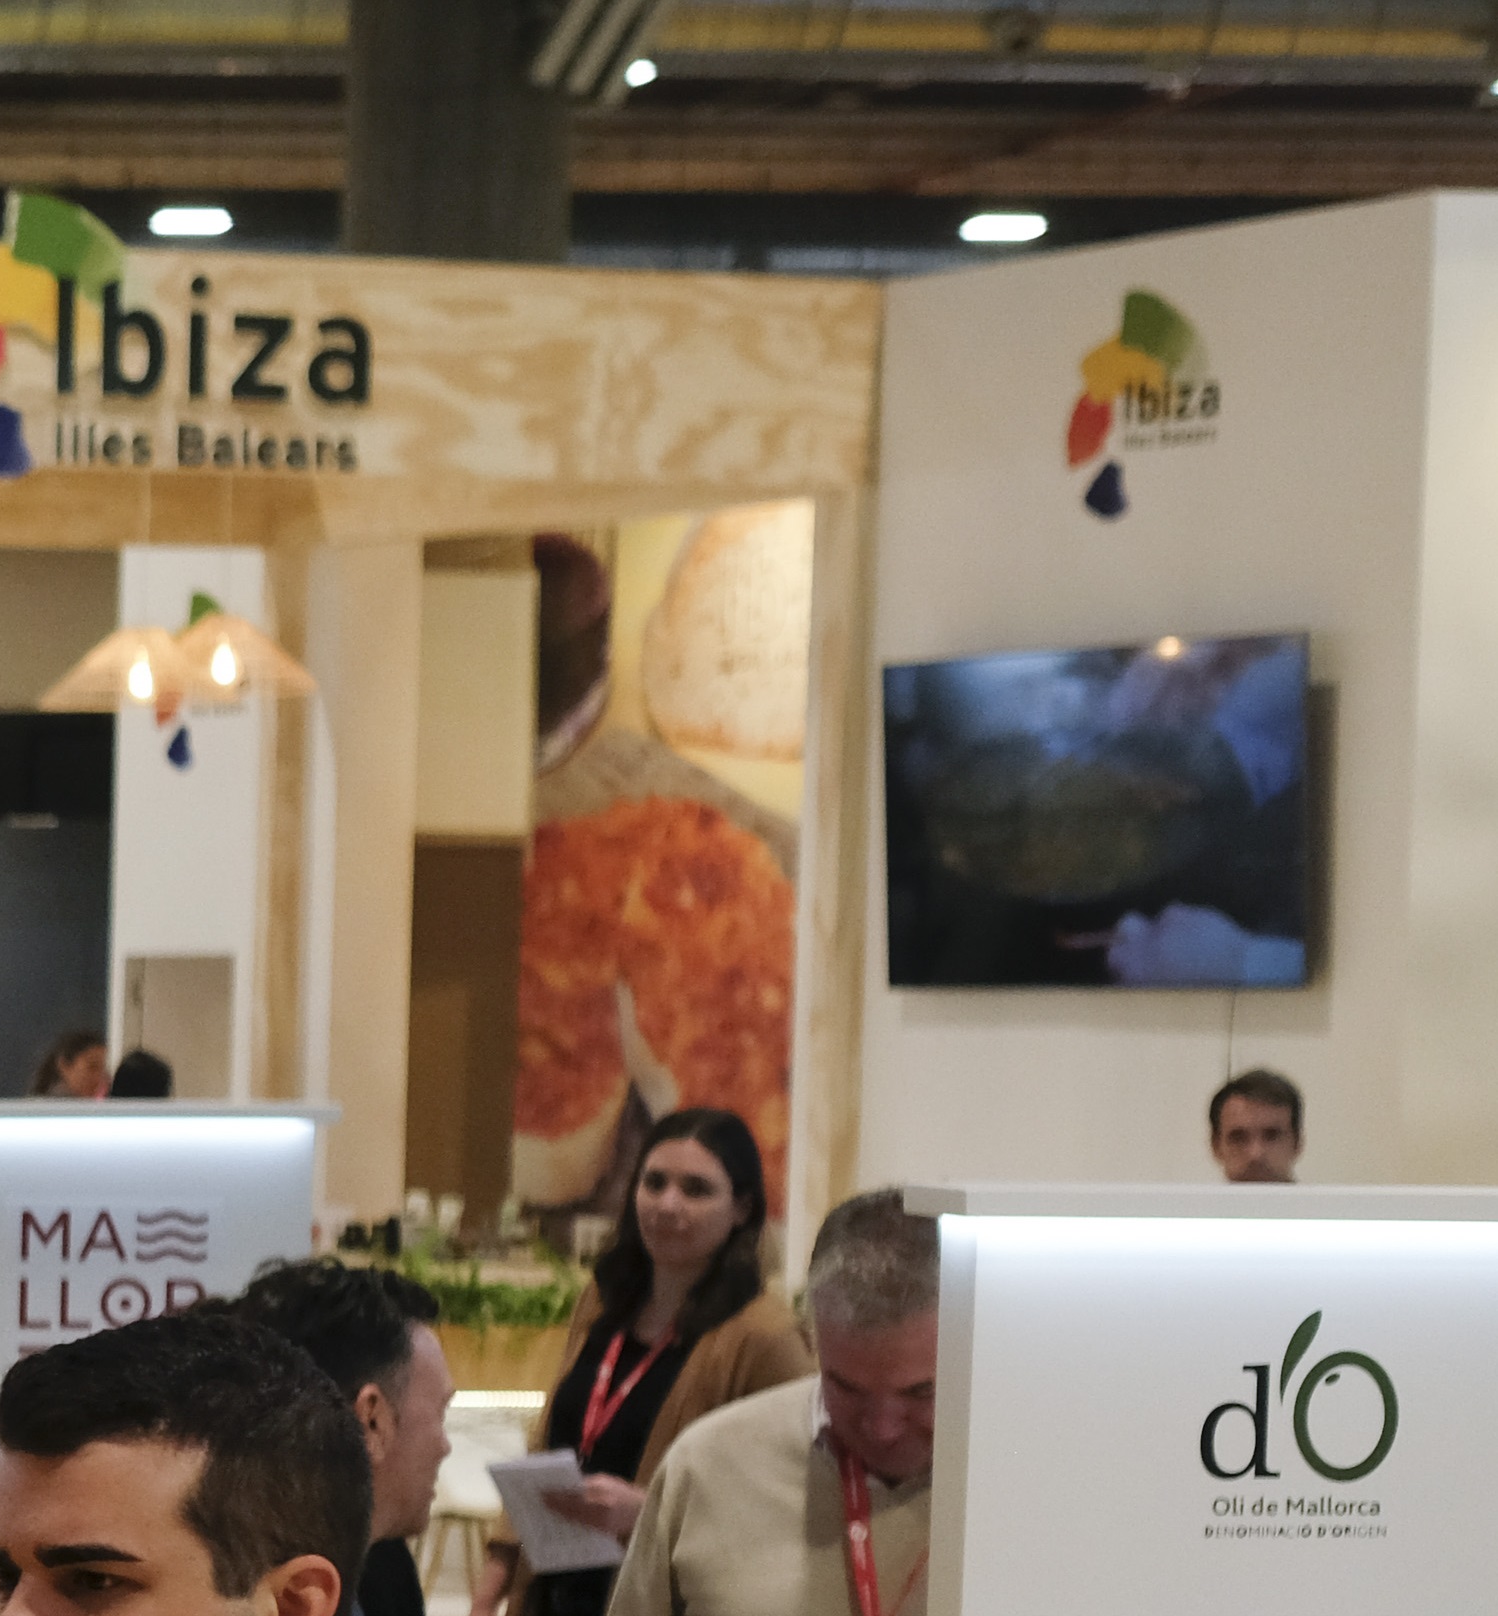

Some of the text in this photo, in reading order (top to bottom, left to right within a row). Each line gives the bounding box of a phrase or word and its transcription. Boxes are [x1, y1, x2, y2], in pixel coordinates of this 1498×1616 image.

[57, 275, 370, 404] Ibiza
[1124, 381, 1222, 424] Ibiza
[177, 423, 359, 473] Balears
[1212, 1495, 1382, 1517] Oli de Mallorca
